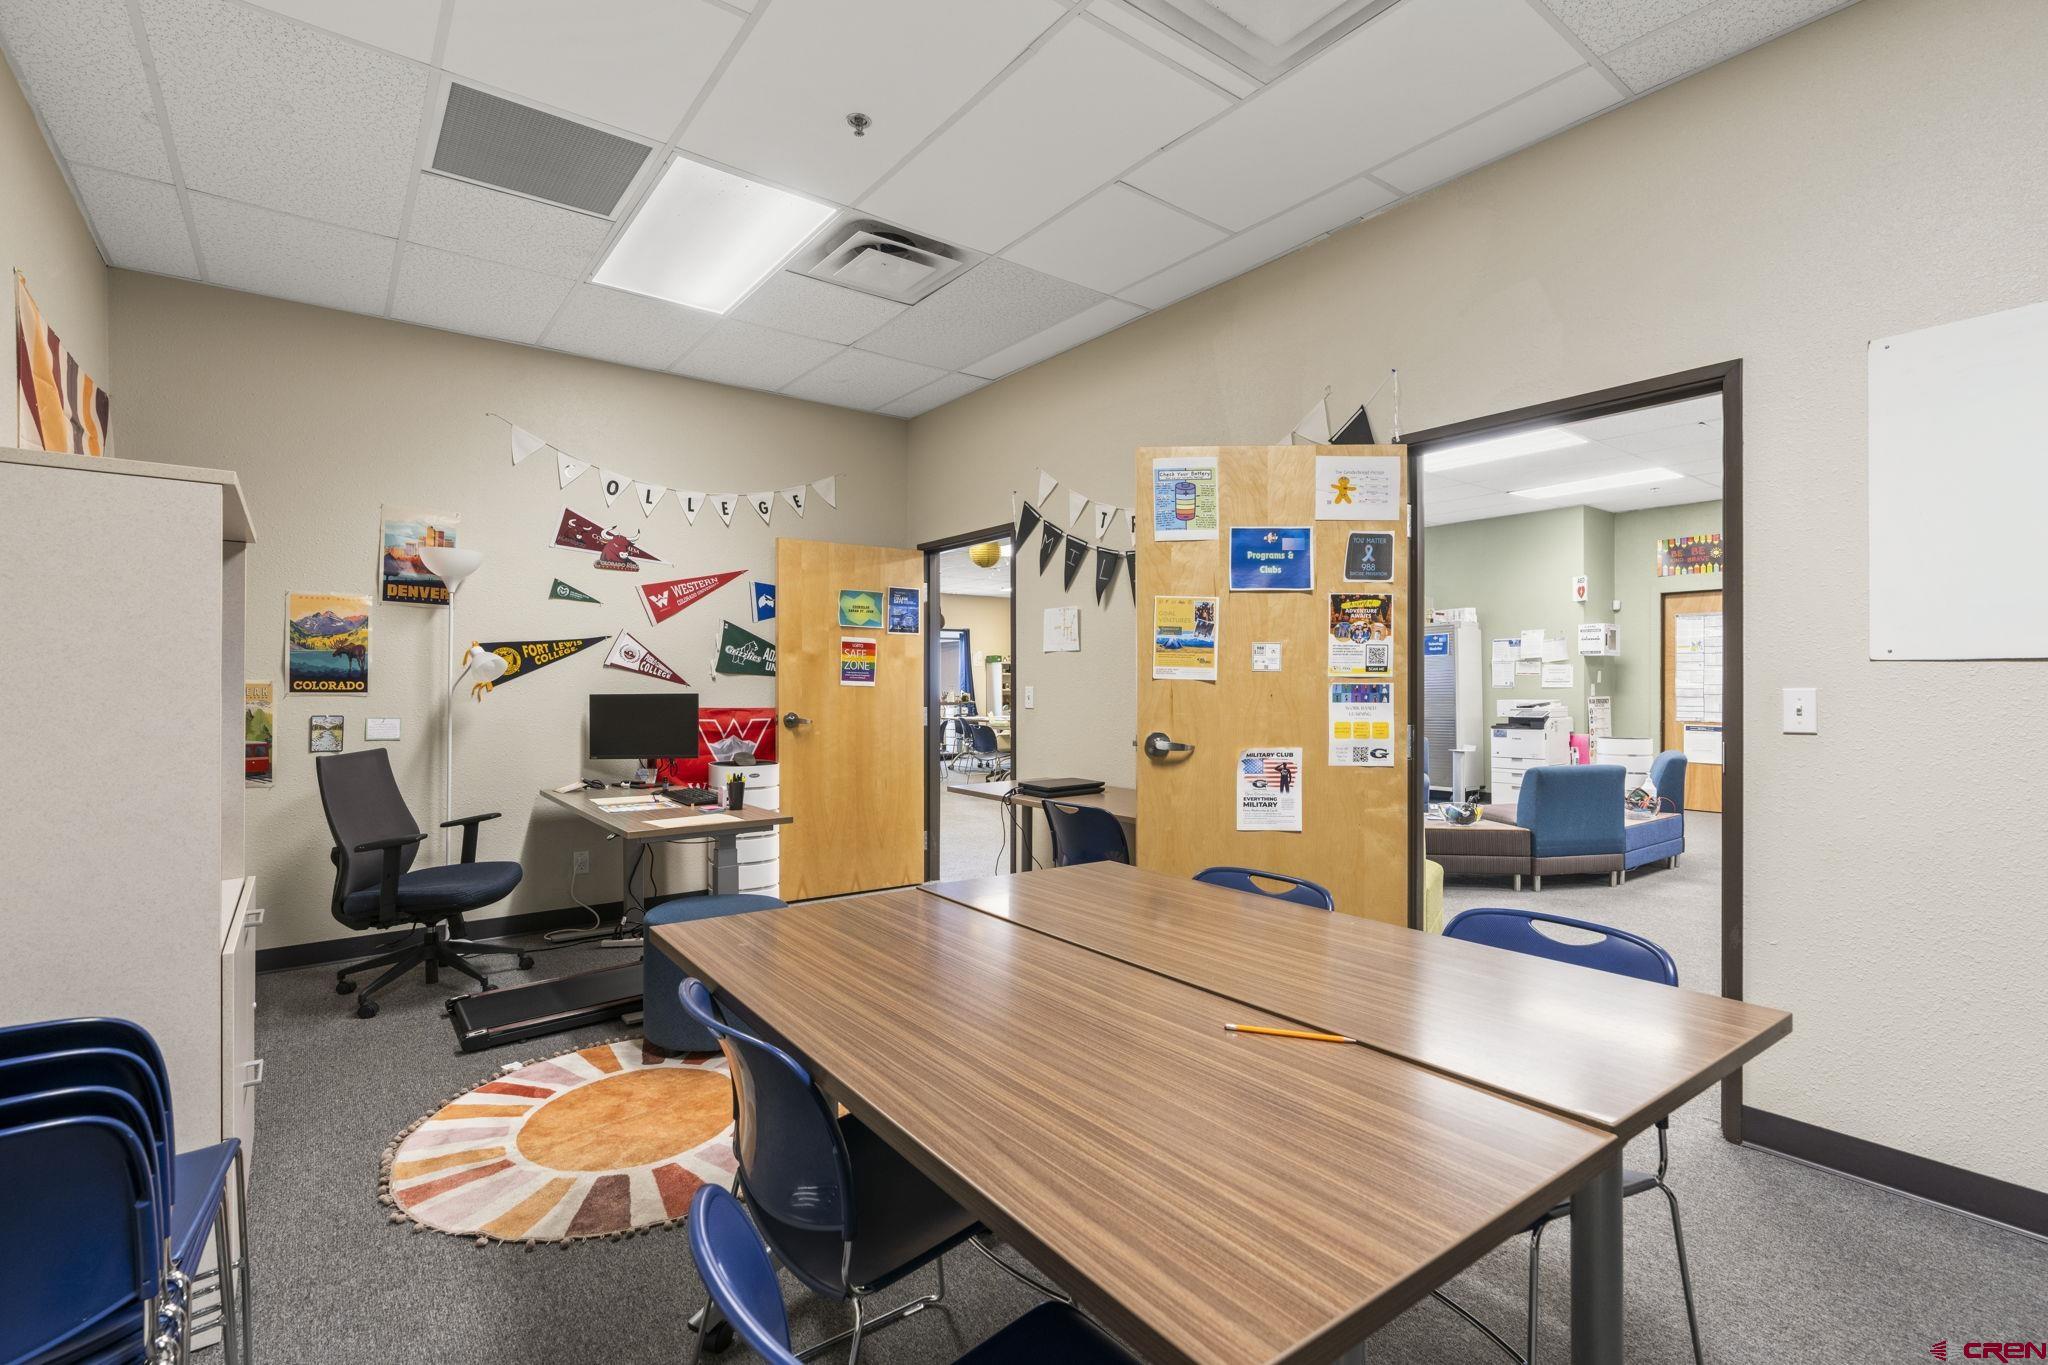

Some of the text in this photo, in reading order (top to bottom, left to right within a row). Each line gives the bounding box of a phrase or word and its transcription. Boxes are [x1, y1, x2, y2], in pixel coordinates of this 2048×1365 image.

[1246, 550, 1294, 561] Programs &
[1259, 565, 1282, 574] Clubs
[1361, 563, 1376, 571] 988
[387, 583, 449, 600] DENVER
[671, 577, 719, 597] WESTERN
[522, 640, 583, 658] FORT LEWIS
[844, 648, 867, 659] SAFE
[534, 646, 577, 665] COLLEGE
[640, 661, 672, 680] COLLEGE
[844, 660, 870, 671] ZONE
[293, 680, 365, 691] COLORADO
